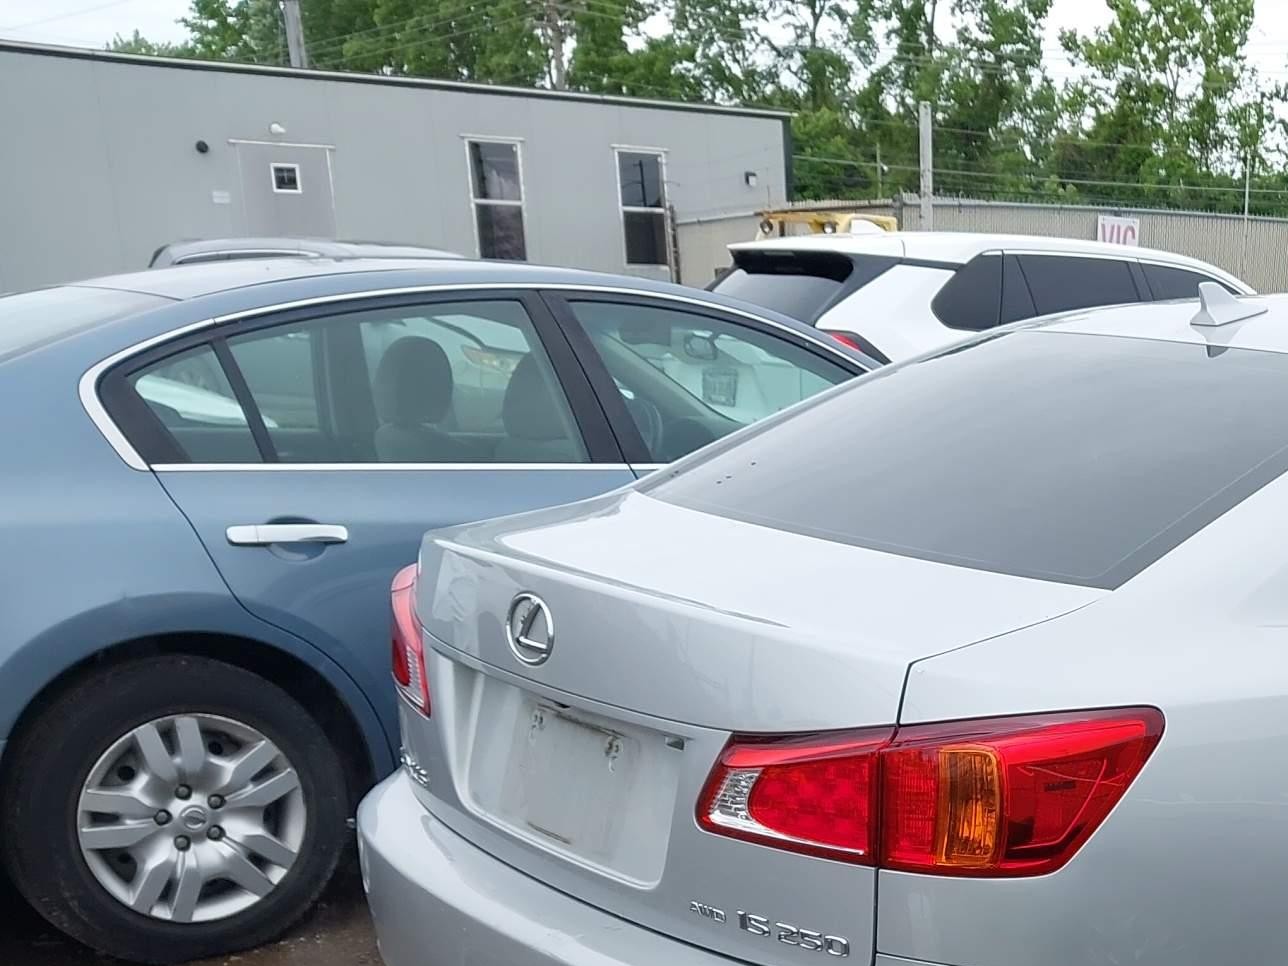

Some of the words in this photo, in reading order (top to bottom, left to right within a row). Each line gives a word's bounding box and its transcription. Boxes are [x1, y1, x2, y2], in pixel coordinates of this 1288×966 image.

[690, 901, 727, 923] AWD
[737, 909, 771, 937] IS
[775, 922, 850, 958] 250
